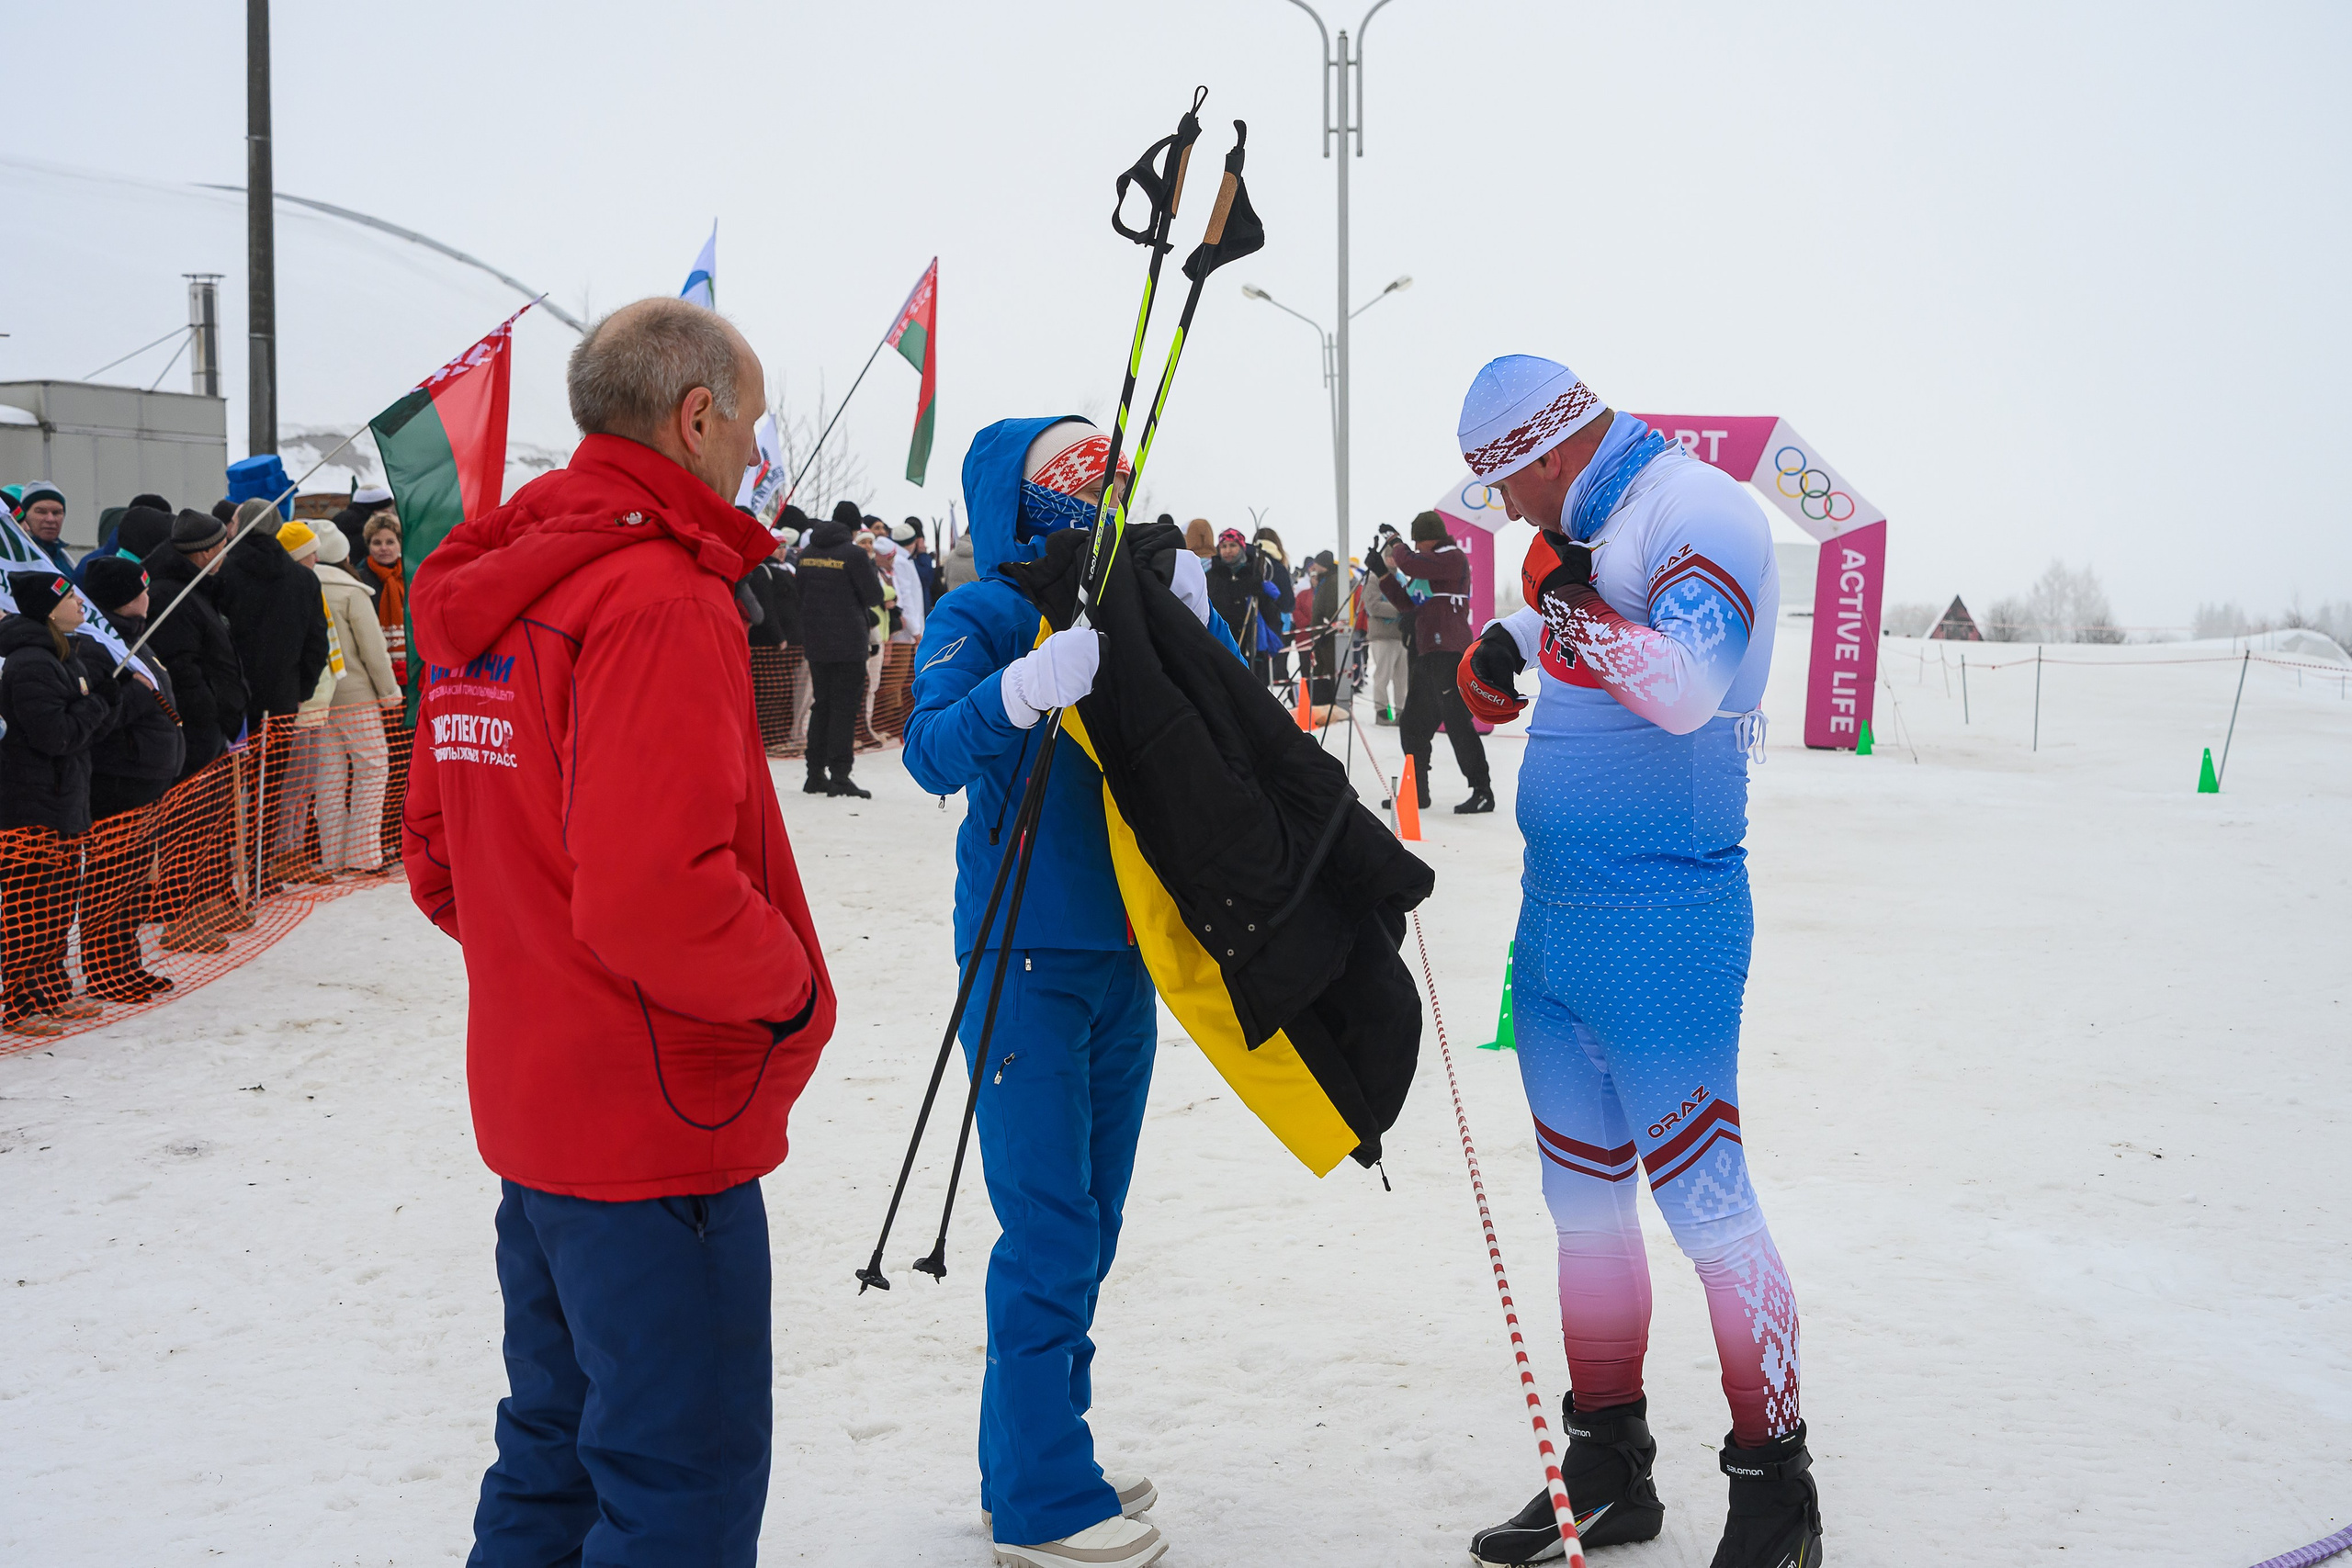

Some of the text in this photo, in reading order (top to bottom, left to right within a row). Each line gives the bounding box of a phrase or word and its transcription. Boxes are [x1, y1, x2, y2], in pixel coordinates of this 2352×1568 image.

[1829, 548, 1867, 734] ACTIVE LIFE
[481, 750, 518, 768] ТРАСС
[1647, 1085, 1710, 1138] ORAZ
